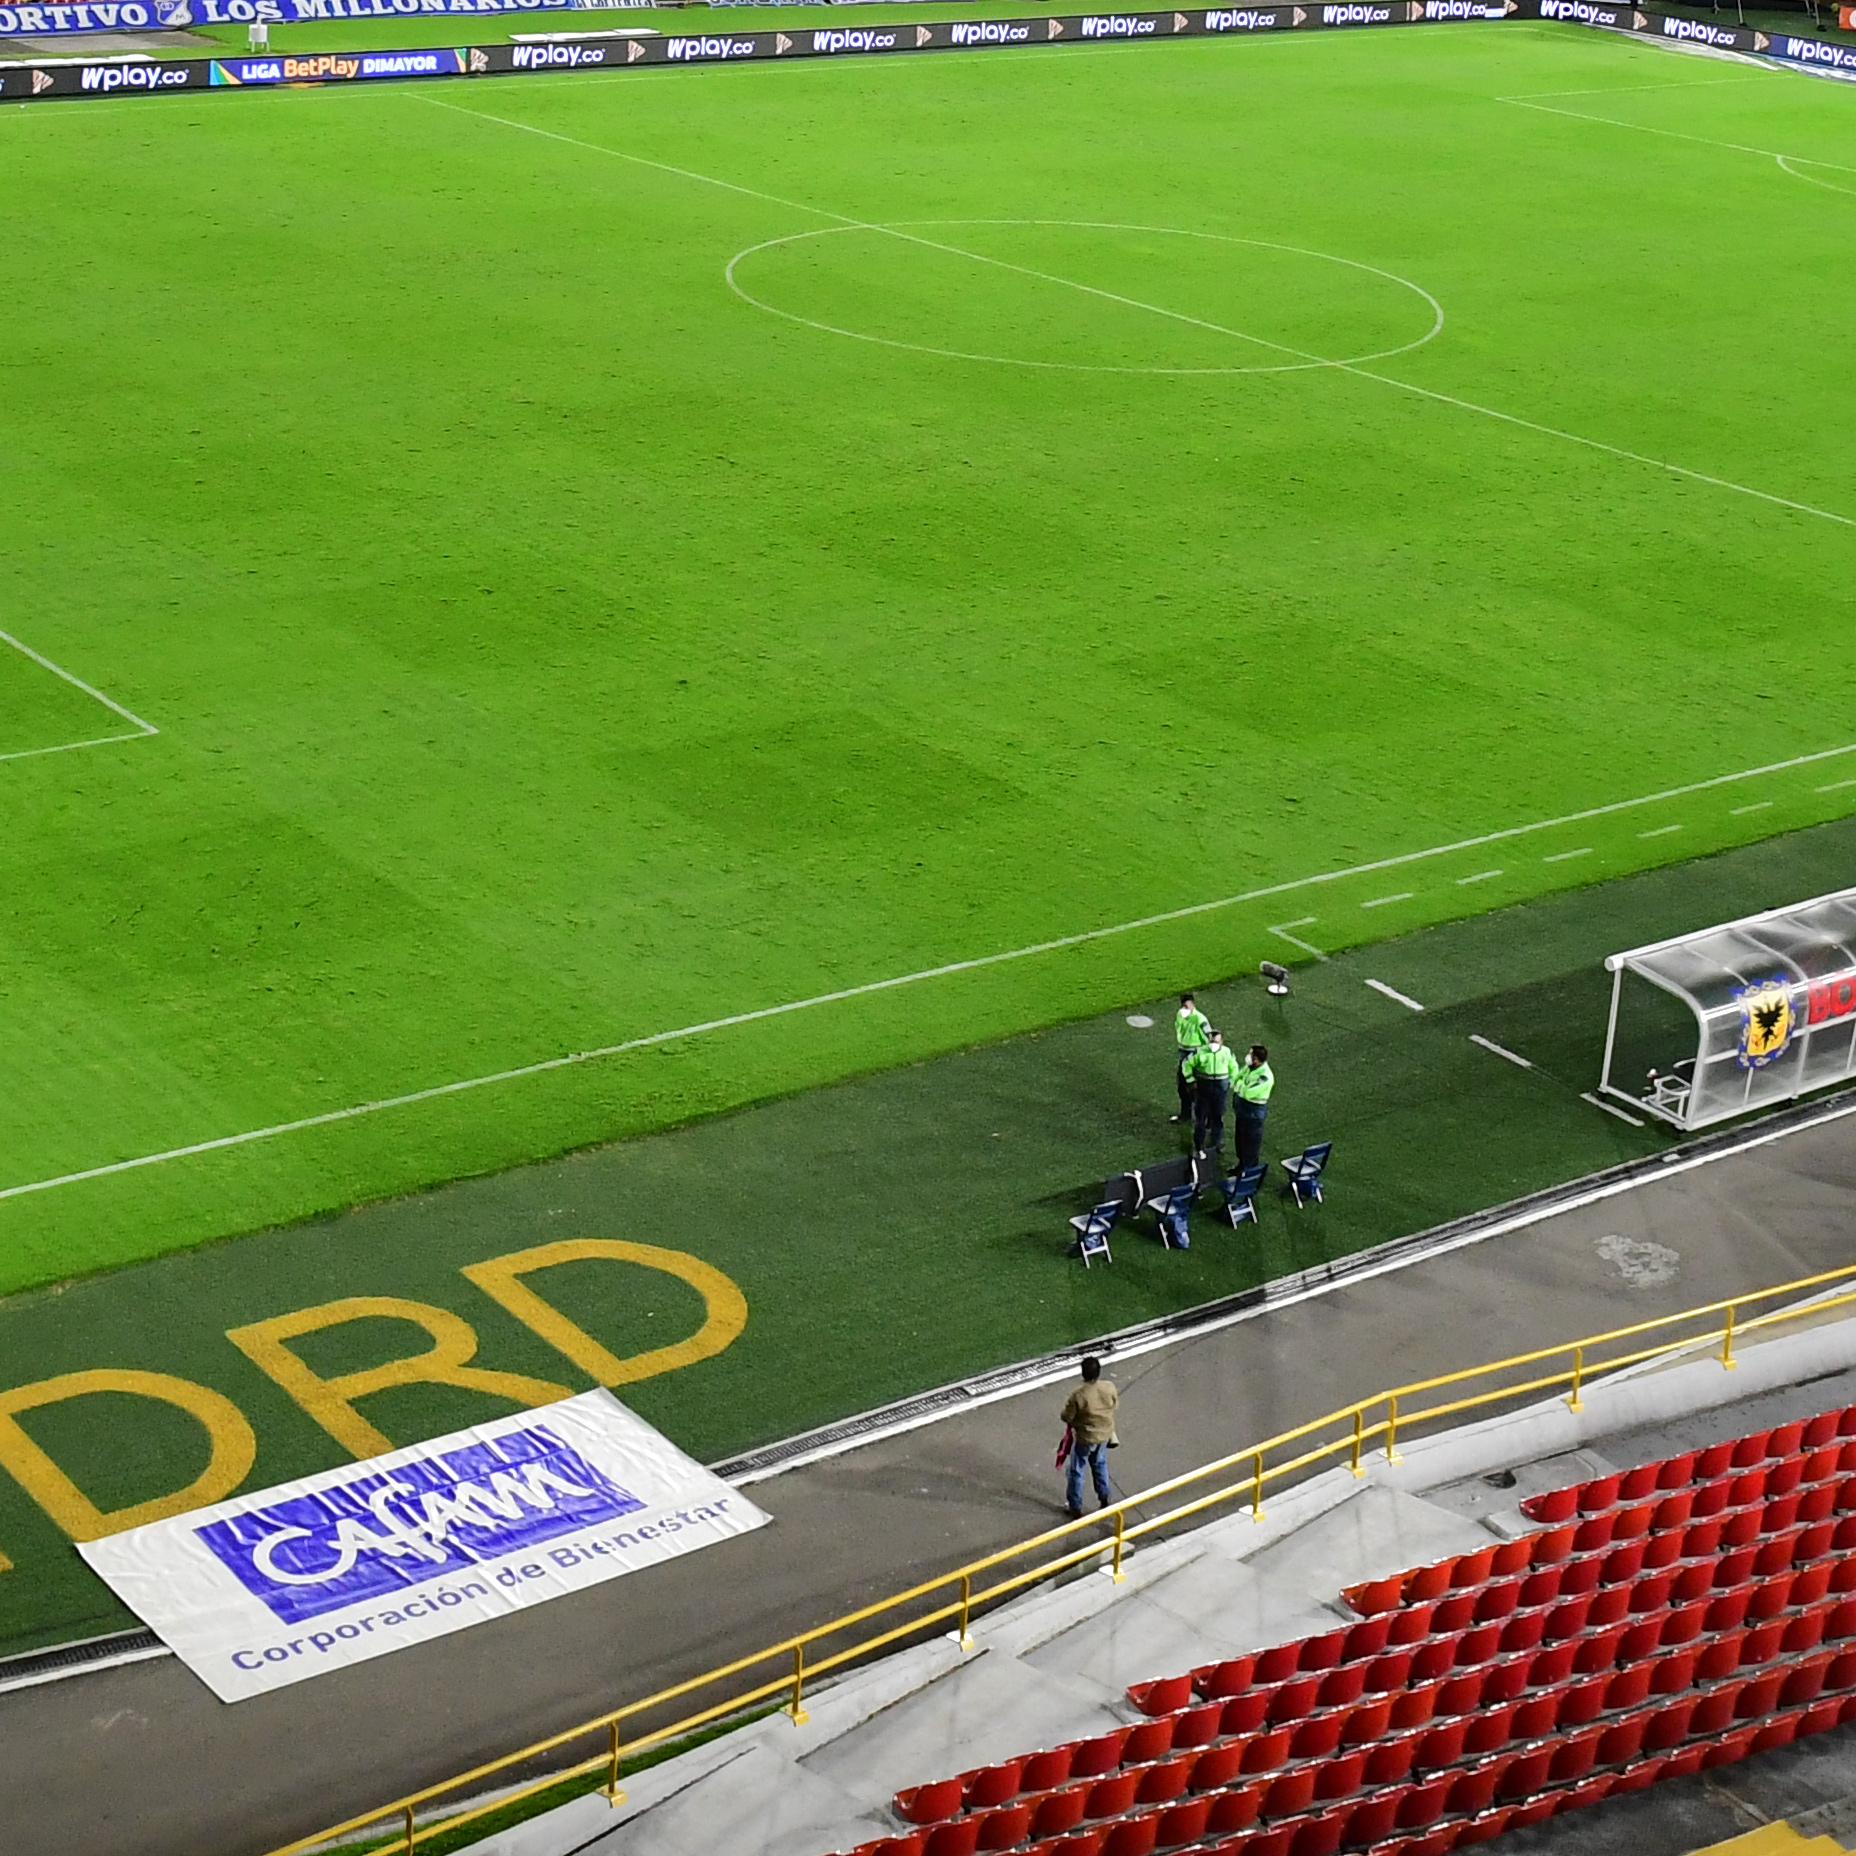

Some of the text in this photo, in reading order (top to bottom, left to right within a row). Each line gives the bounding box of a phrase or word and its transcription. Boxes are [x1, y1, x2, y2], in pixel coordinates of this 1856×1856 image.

[1082, 15, 1155, 38] Wplay.co
[1205, 9, 1276, 32] Wplay.co
[1324, 3, 1390, 26] Wplay.co
[813, 29, 895, 53] Wplay.co
[952, 23, 1029, 46] Wplay.co
[1664, 16, 1736, 46] Wplay.co
[513, 45, 604, 71] Wplay.co
[667, 36, 755, 61] Wplay.co
[81, 62, 188, 93] Wplay.co
[242, 55, 438, 81] LIGA BetPlay DIMAYOR
[228, 1495, 738, 1673] Corporación de Bienestar
